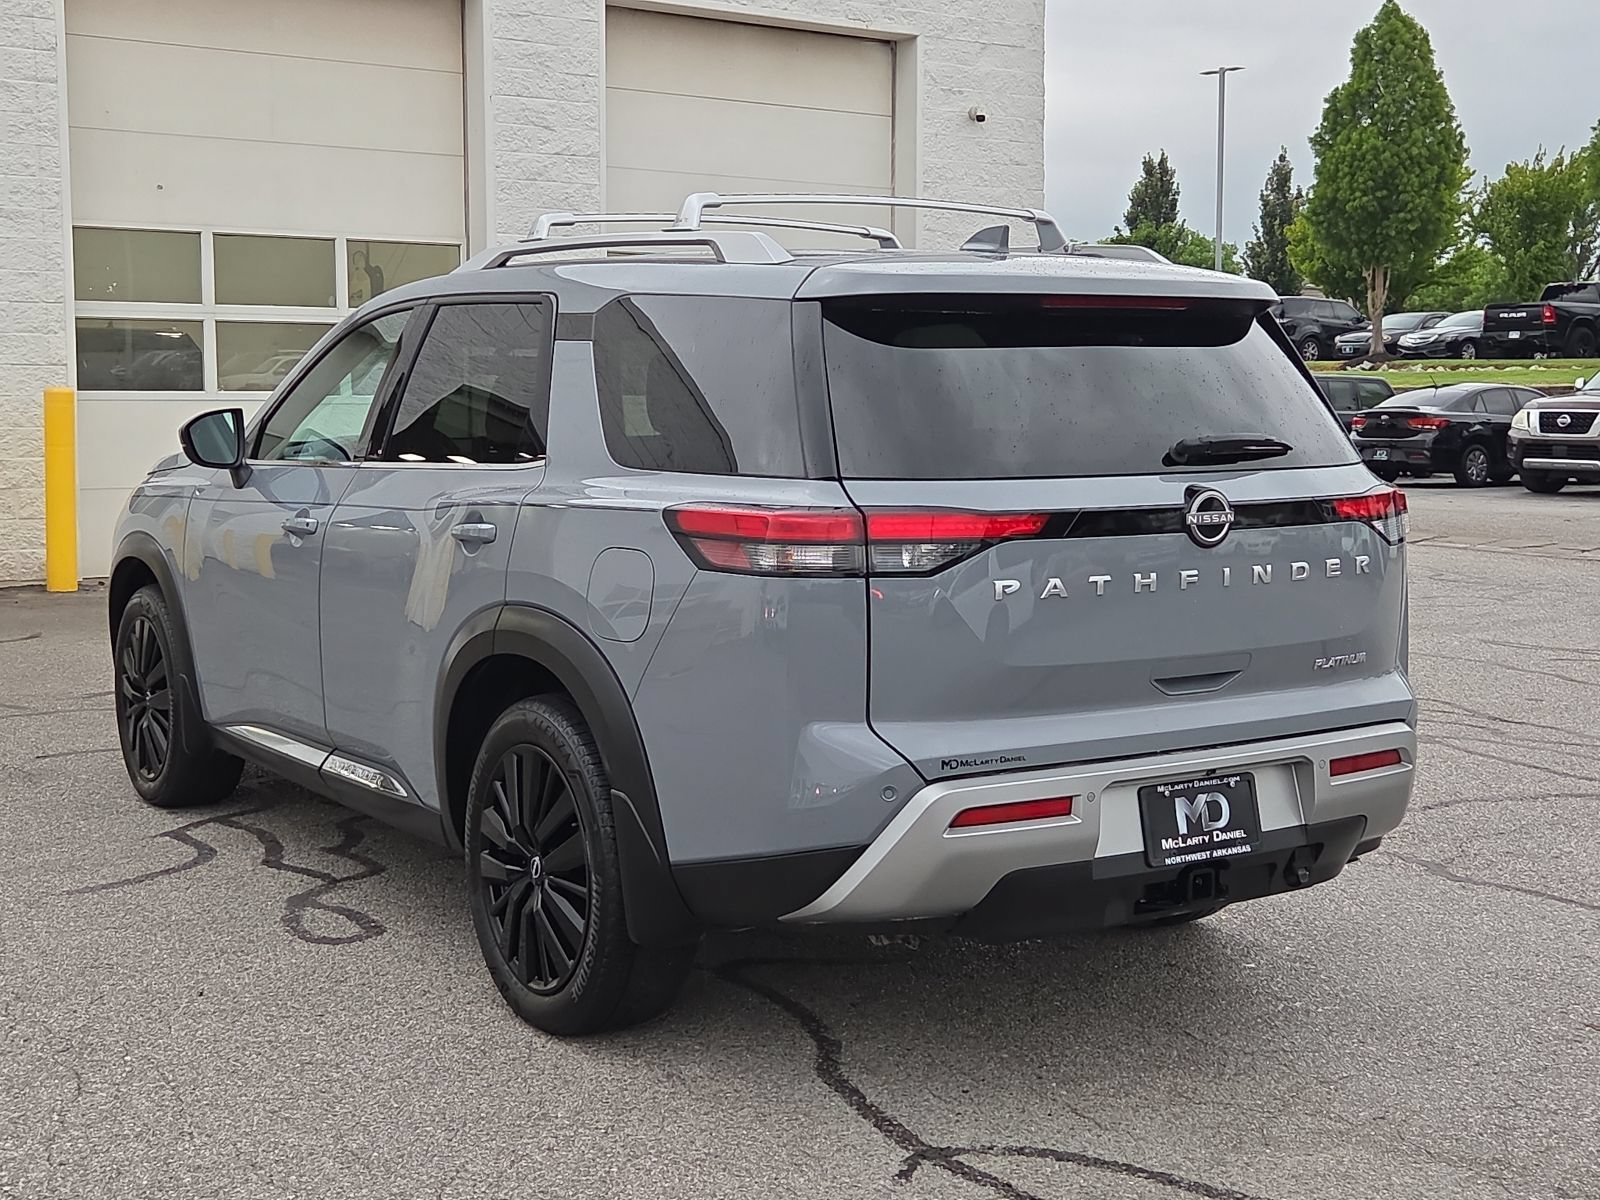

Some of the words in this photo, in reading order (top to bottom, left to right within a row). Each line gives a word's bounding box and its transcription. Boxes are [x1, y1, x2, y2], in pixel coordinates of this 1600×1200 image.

[1499, 311, 1528, 319] RAM
[1187, 513, 1235, 524] NISSAN
[992, 554, 1371, 602] PATHFINDER
[1312, 651, 1367, 671] PLATINUM
[1174, 791, 1231, 835] MD
[1161, 834, 1210, 851] McLARTY
[1212, 829, 1248, 843] DANIEL
[1164, 850, 1212, 866] NORTHWEST
[1212, 844, 1252, 859] ARKANSAS
